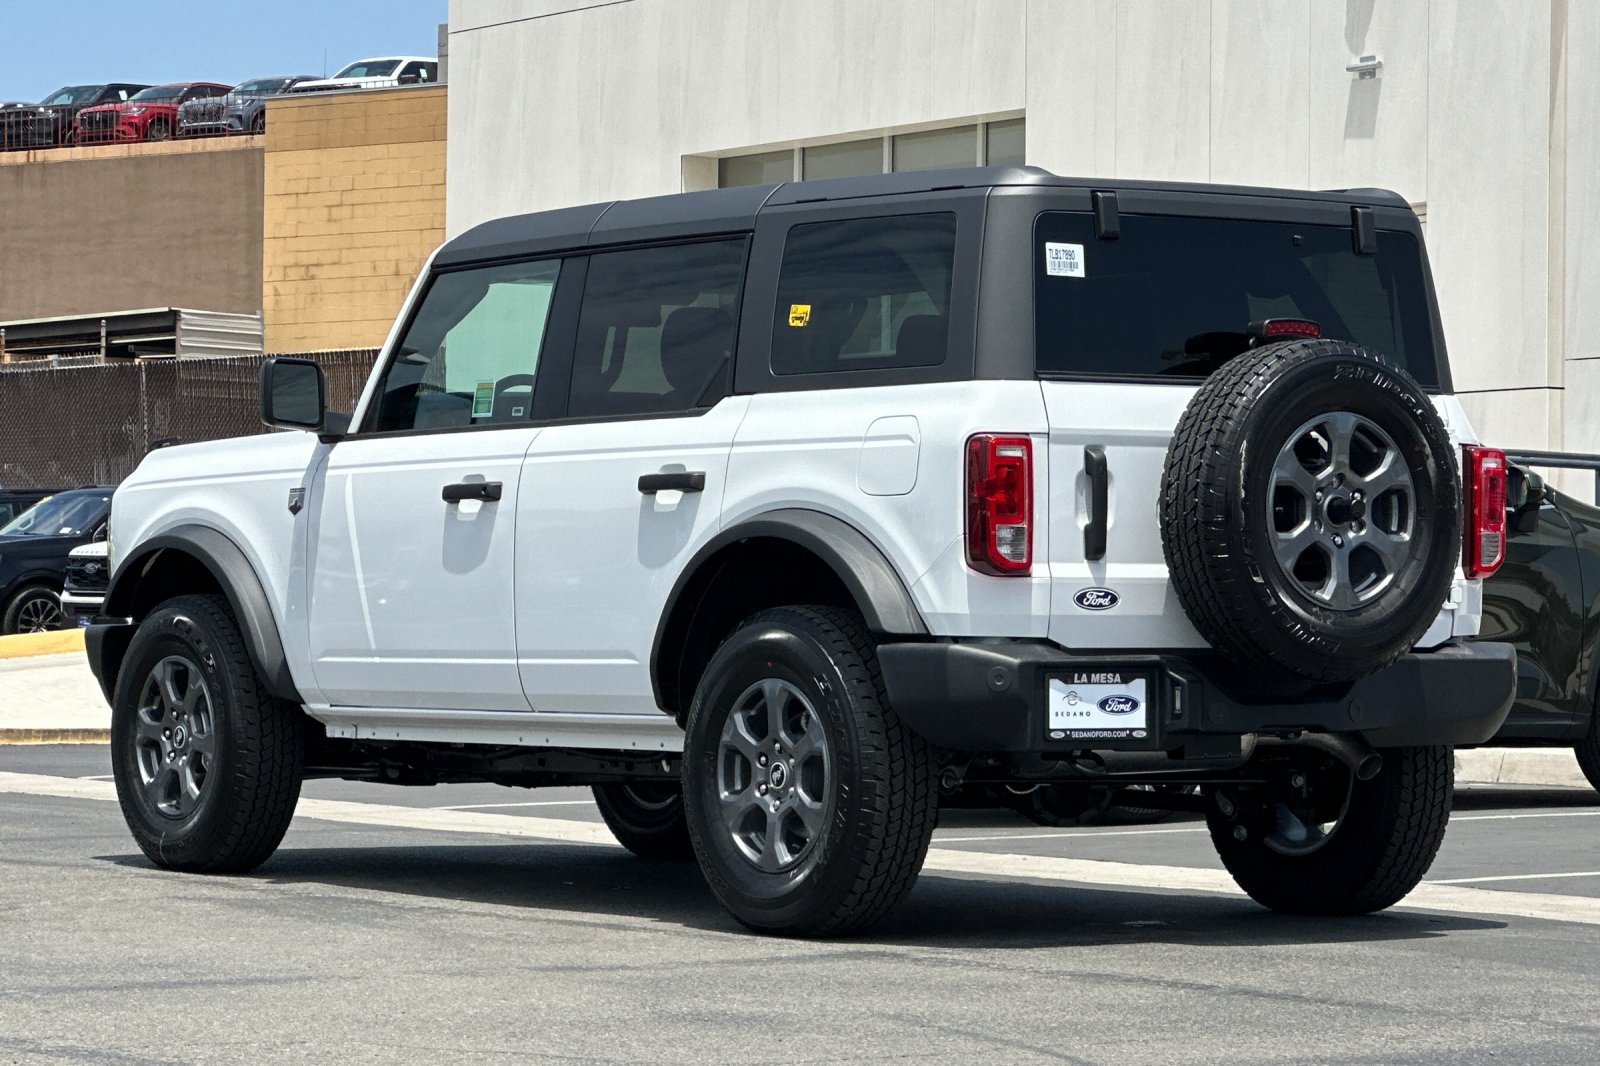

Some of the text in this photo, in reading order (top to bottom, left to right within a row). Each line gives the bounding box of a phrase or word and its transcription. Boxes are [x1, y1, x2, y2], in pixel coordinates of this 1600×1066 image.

[1083, 591, 1111, 605] Ford
[1073, 673, 1121, 684] LA MESA
[1105, 698, 1132, 712] Ford
[1071, 730, 1127, 739] SEDANOFORD.COM
